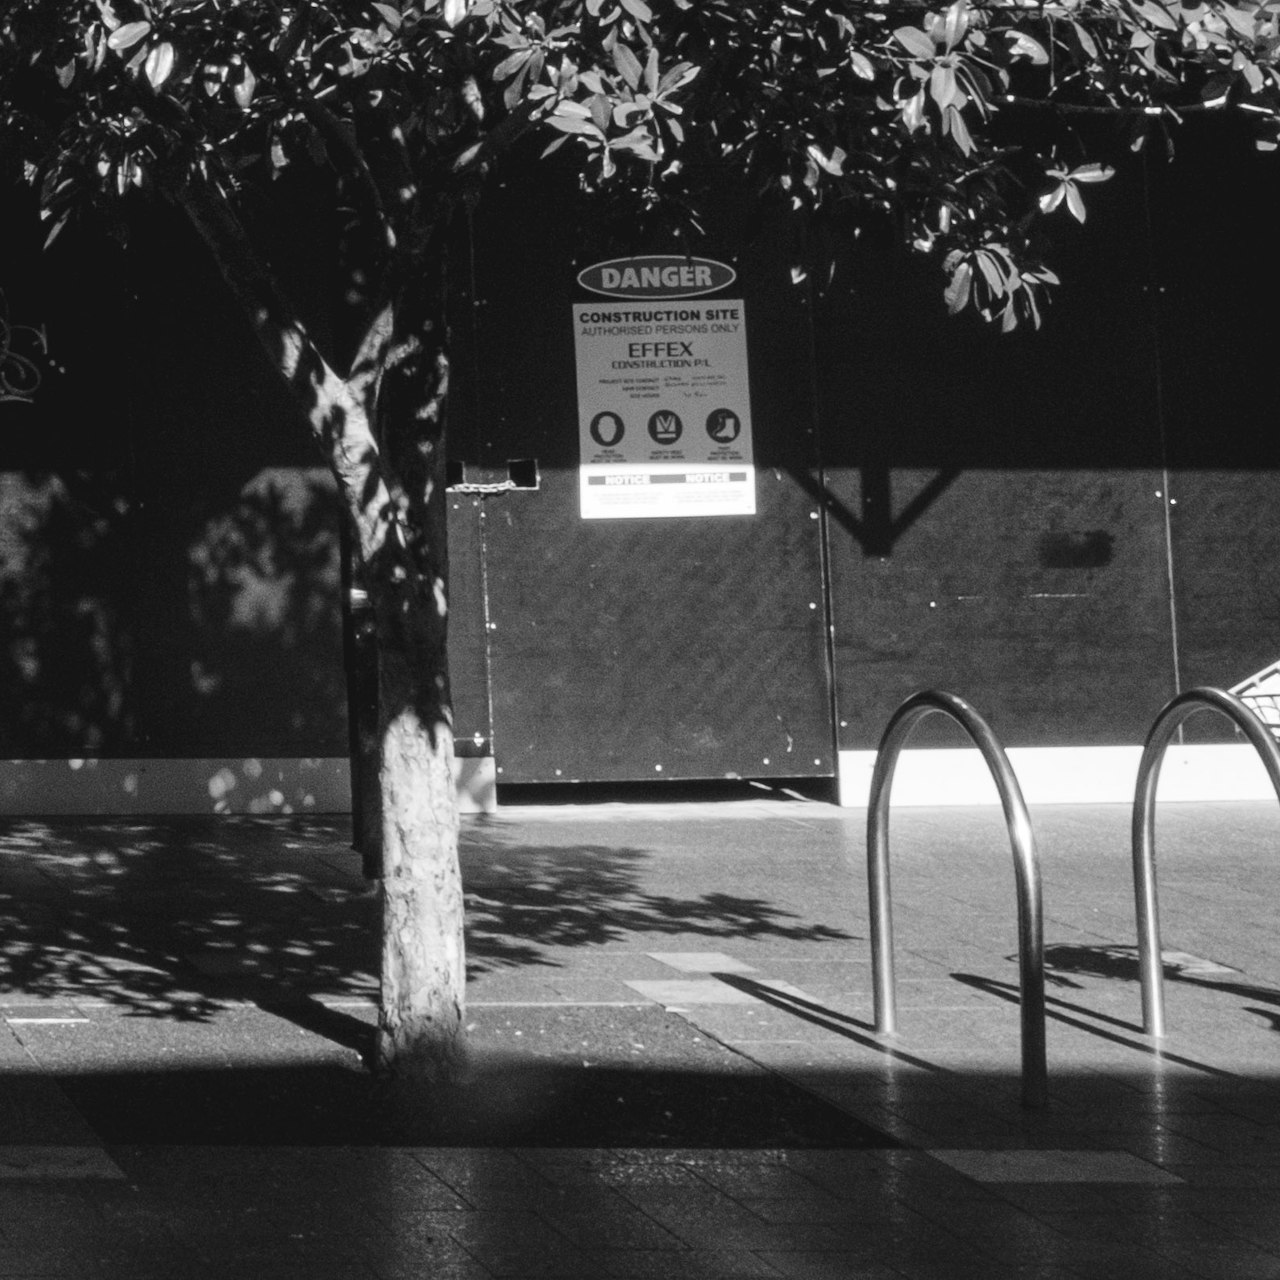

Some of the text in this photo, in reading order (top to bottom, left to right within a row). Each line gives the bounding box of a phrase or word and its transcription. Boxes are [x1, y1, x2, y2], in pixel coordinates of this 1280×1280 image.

[601, 265, 713, 289] DANGER
[579, 309, 740, 324] CONSTRUCTION SITE
[581, 323, 740, 337] AUTHORISED PERSONS ONLY
[628, 341, 694, 359] EFFEX
[611, 360, 692, 370] CONSTRUCTION
[606, 474, 649, 485] NOTICE
[686, 472, 729, 484] NOTICE
